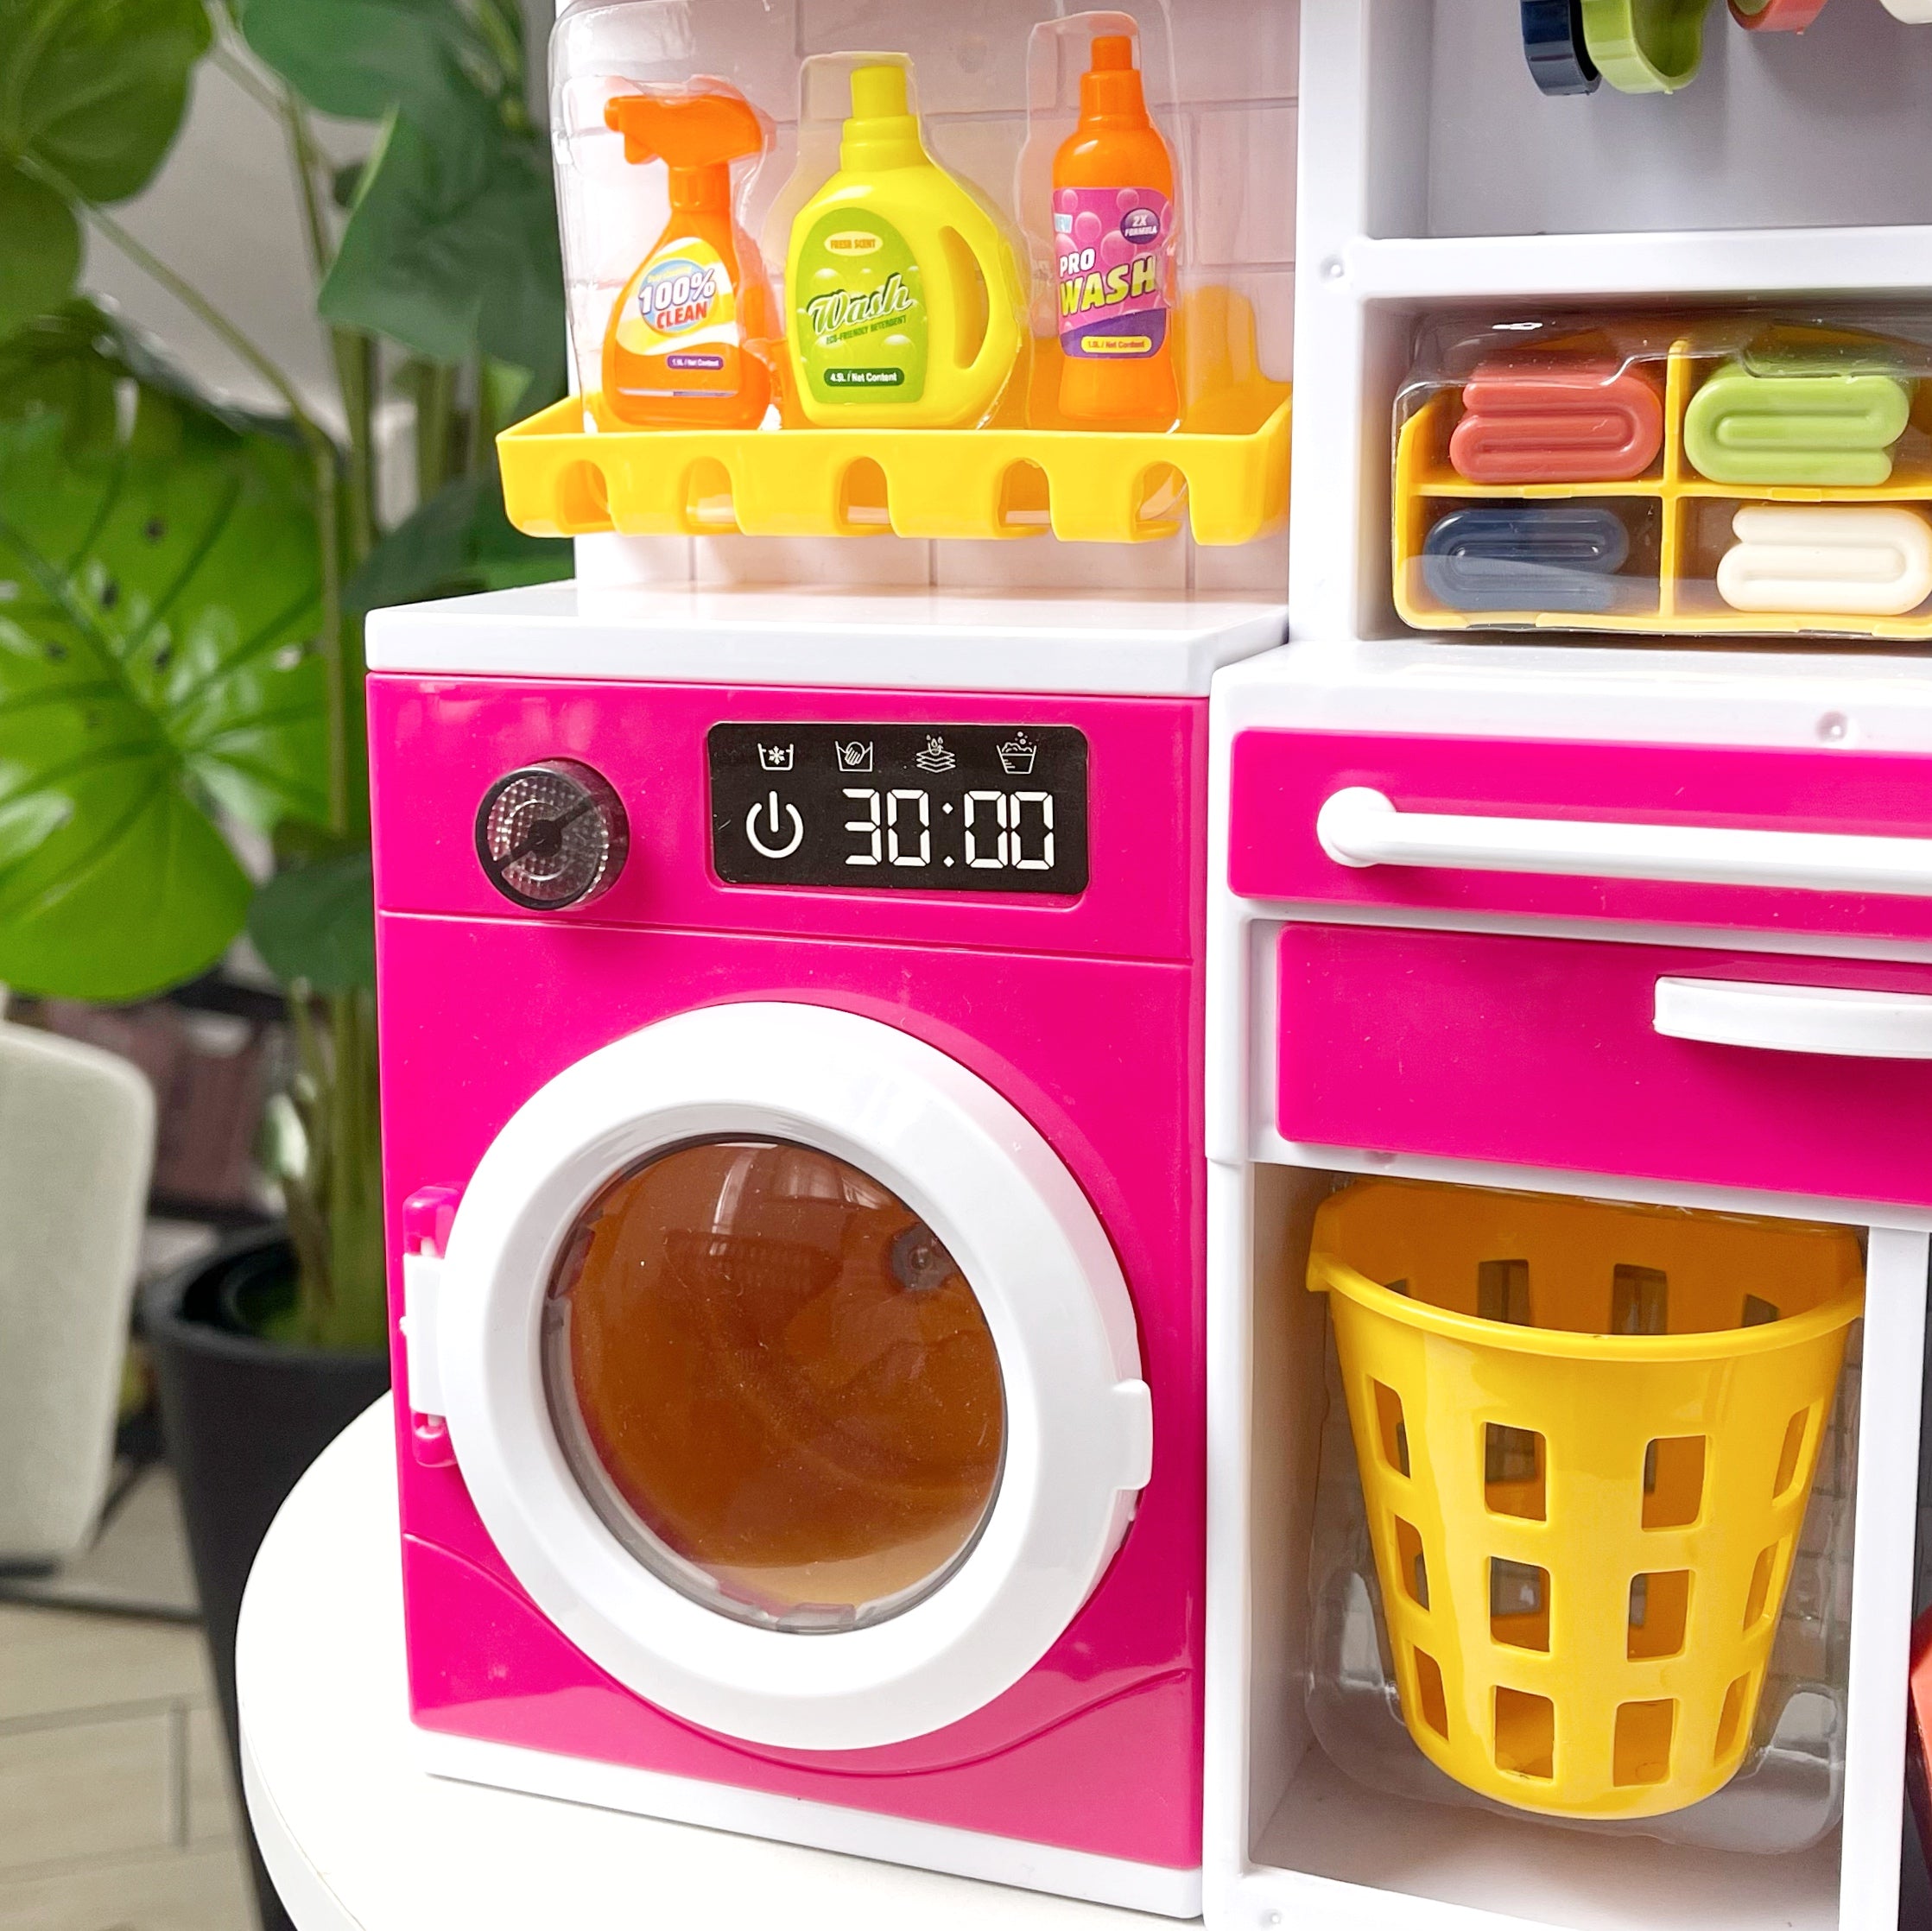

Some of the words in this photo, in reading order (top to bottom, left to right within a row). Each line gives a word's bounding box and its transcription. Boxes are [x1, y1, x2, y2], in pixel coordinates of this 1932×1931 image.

[1132, 215, 1148, 227] 2X
[854, 238, 875, 249] SCENT
[1060, 248, 1096, 277] PRO
[638, 269, 716, 314] 100%
[1060, 256, 1156, 317] WASH
[656, 301, 707, 329] CLEAN
[807, 272, 914, 335] Wash
[852, 372, 865, 382] Net
[865, 372, 897, 382] Content
[844, 788, 1056, 871] 30:00
